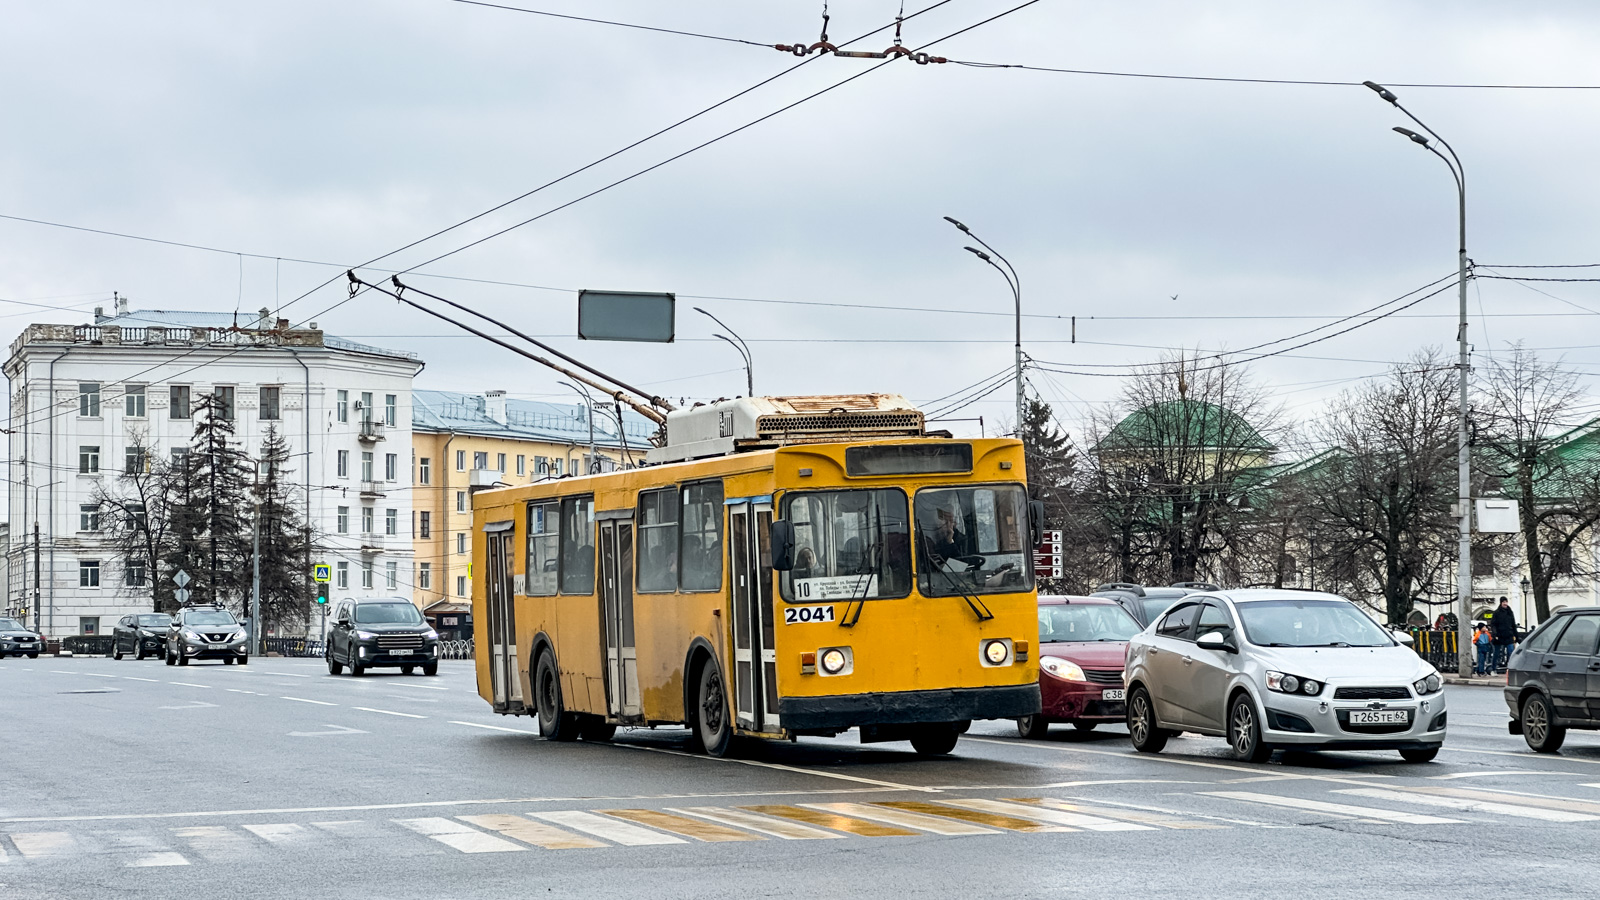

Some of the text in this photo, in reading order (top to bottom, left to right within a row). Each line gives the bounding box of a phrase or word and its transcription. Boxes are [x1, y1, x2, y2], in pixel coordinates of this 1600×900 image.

[797, 582, 810, 598] 10
[785, 606, 834, 622] 2041
[1105, 690, 1125, 699] С38
[1395, 711, 1405, 719] 62
